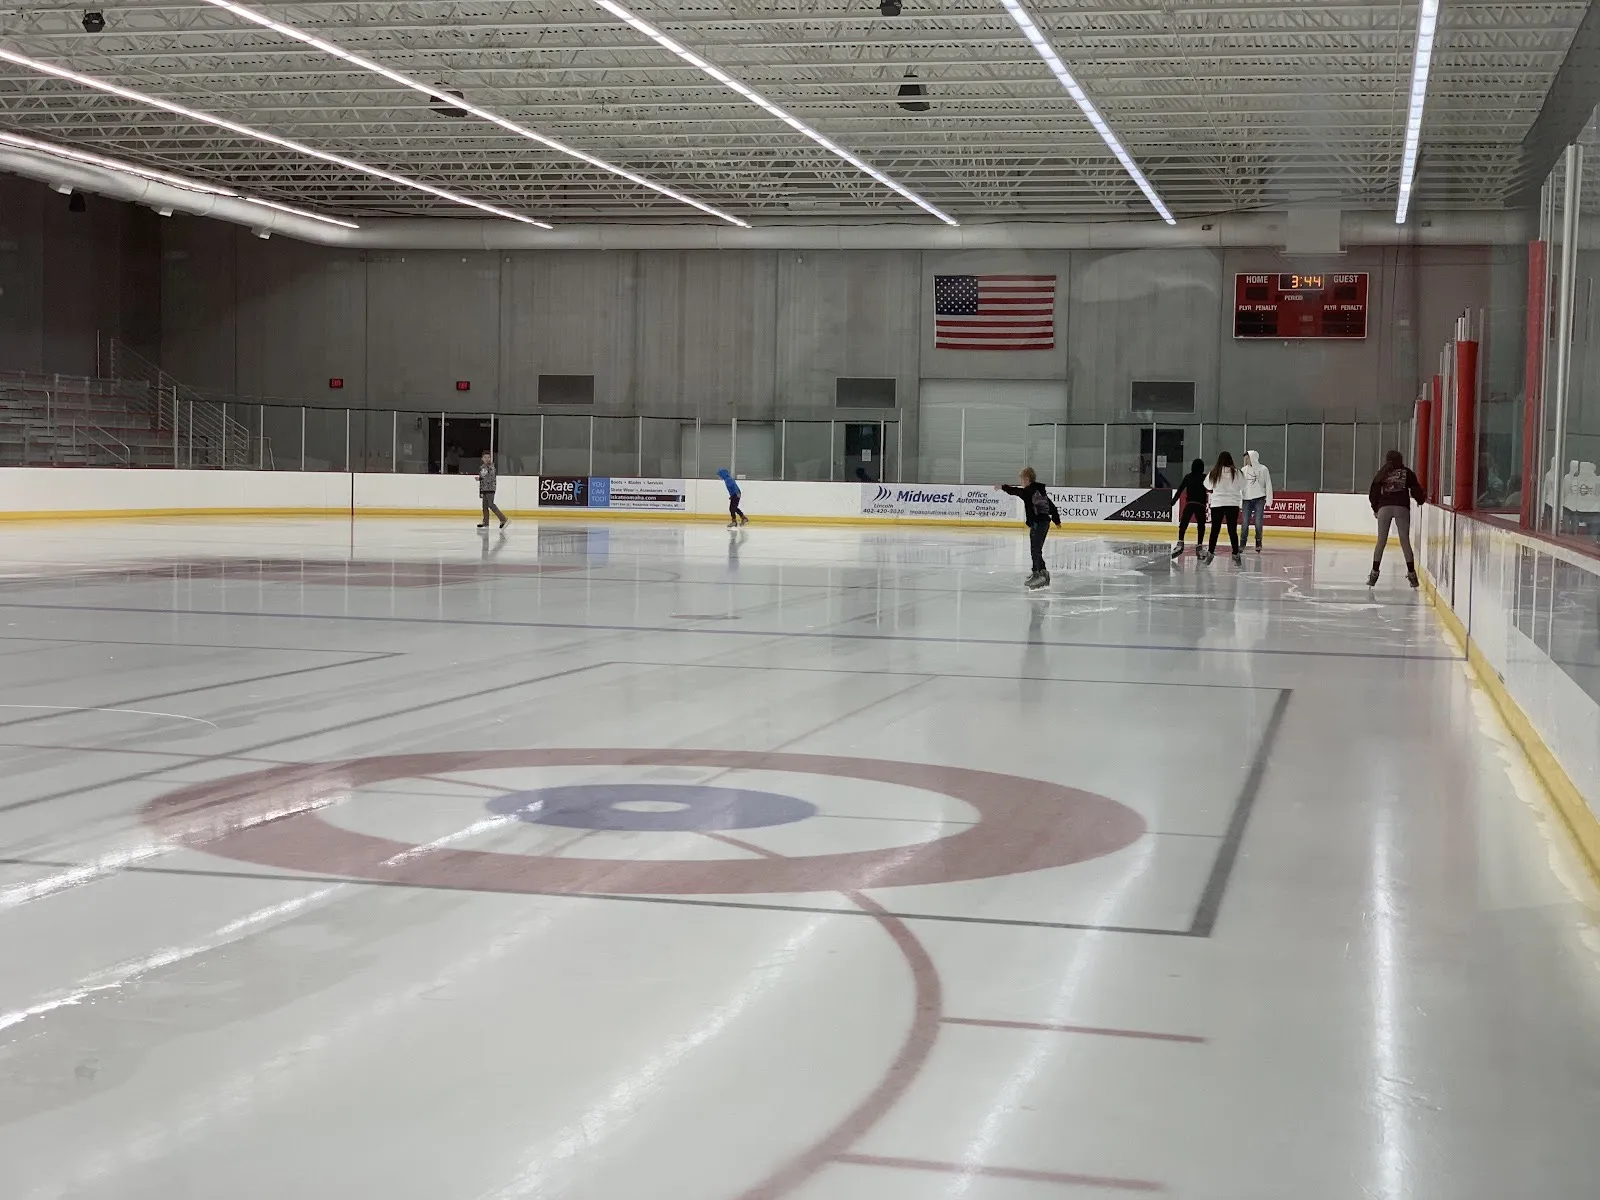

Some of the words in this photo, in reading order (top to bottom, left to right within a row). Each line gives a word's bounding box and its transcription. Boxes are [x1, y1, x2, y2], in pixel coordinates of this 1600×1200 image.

[1246, 275, 1268, 284] HOME
[1291, 275, 1321, 288] 3:44
[1333, 275, 1358, 283] GUEST
[540, 480, 573, 491] iSkate
[540, 490, 573, 500] Omaha
[896, 490, 954, 503] Midwest
[1097, 493, 1127, 504] TITLE
[1287, 503, 1306, 512] FIRM
[1120, 510, 1171, 519] 402.435.1244
